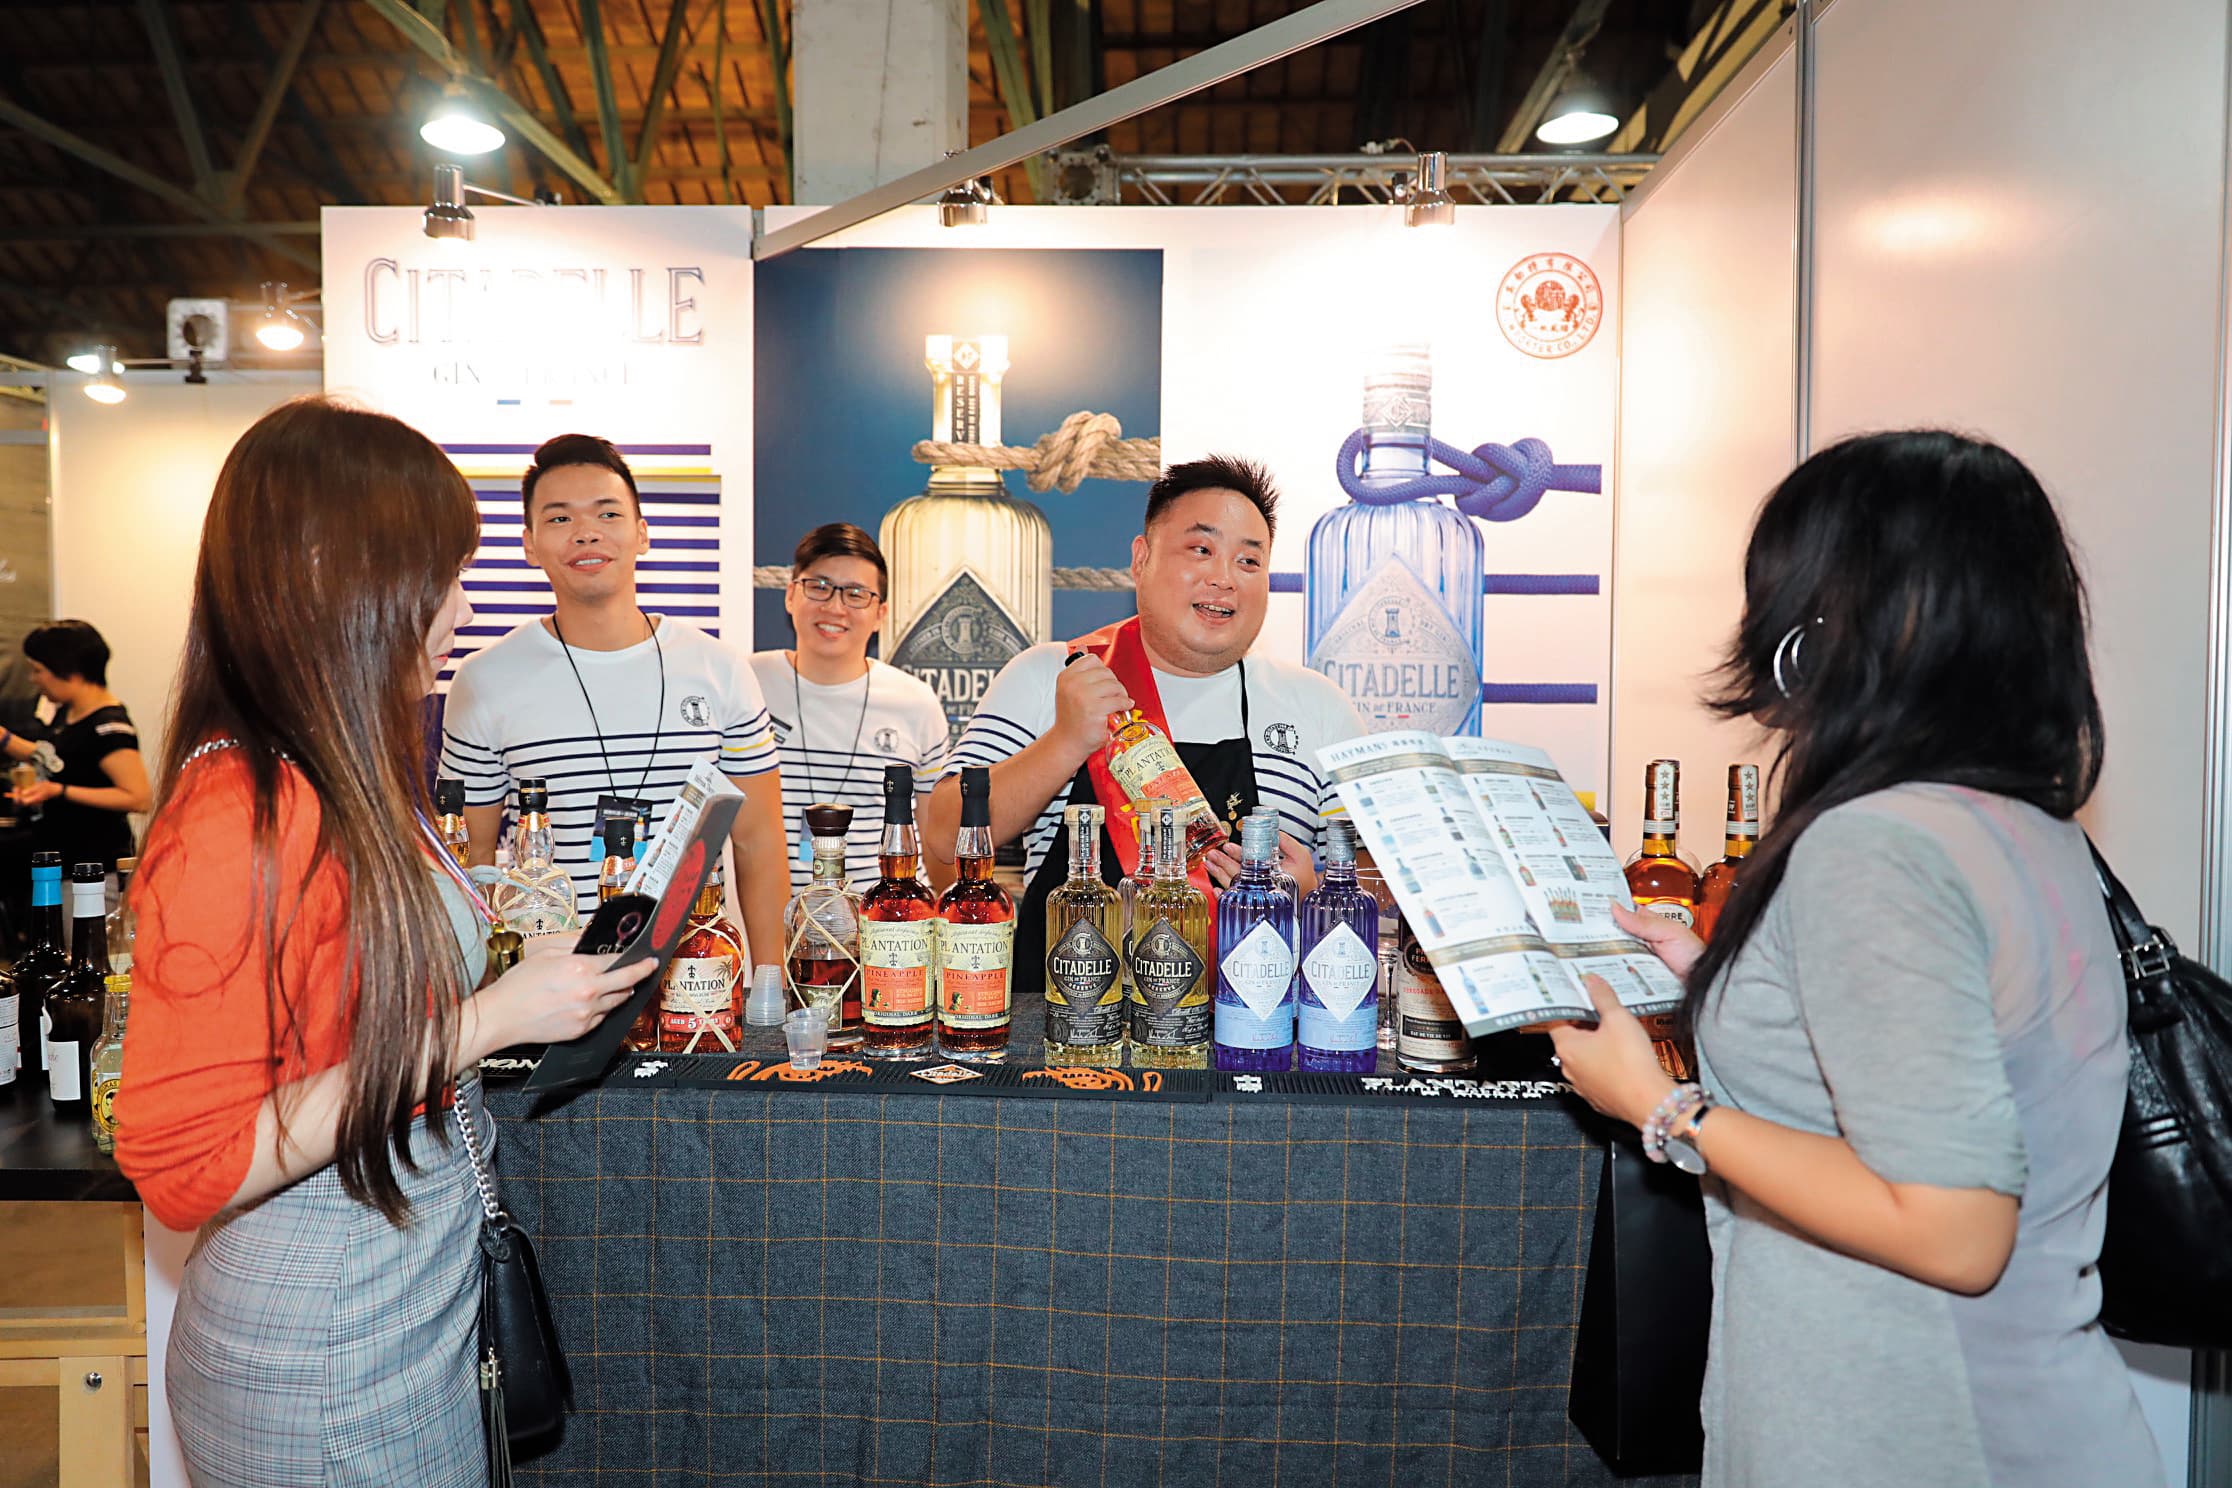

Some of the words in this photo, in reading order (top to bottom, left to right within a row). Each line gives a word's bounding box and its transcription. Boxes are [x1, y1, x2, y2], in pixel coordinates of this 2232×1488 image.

[364, 257, 705, 344] CITLE
[955, 374, 966, 442] RESERV
[1353, 701, 1370, 713] IN
[1387, 702, 1436, 713] FRANCE
[860, 937, 929, 951] PLANTATION
[940, 940, 1008, 954] PLANTATION
[866, 969, 923, 978] PINEAPPLE
[1053, 957, 1112, 976] CITADELLE
[1135, 958, 1192, 978] CITADELLE
[1232, 960, 1290, 979] CITADELLE
[946, 972, 1004, 981] PINEAPPLE
[664, 979, 725, 991] PLNTATION
[688, 1018, 697, 1029] 5
